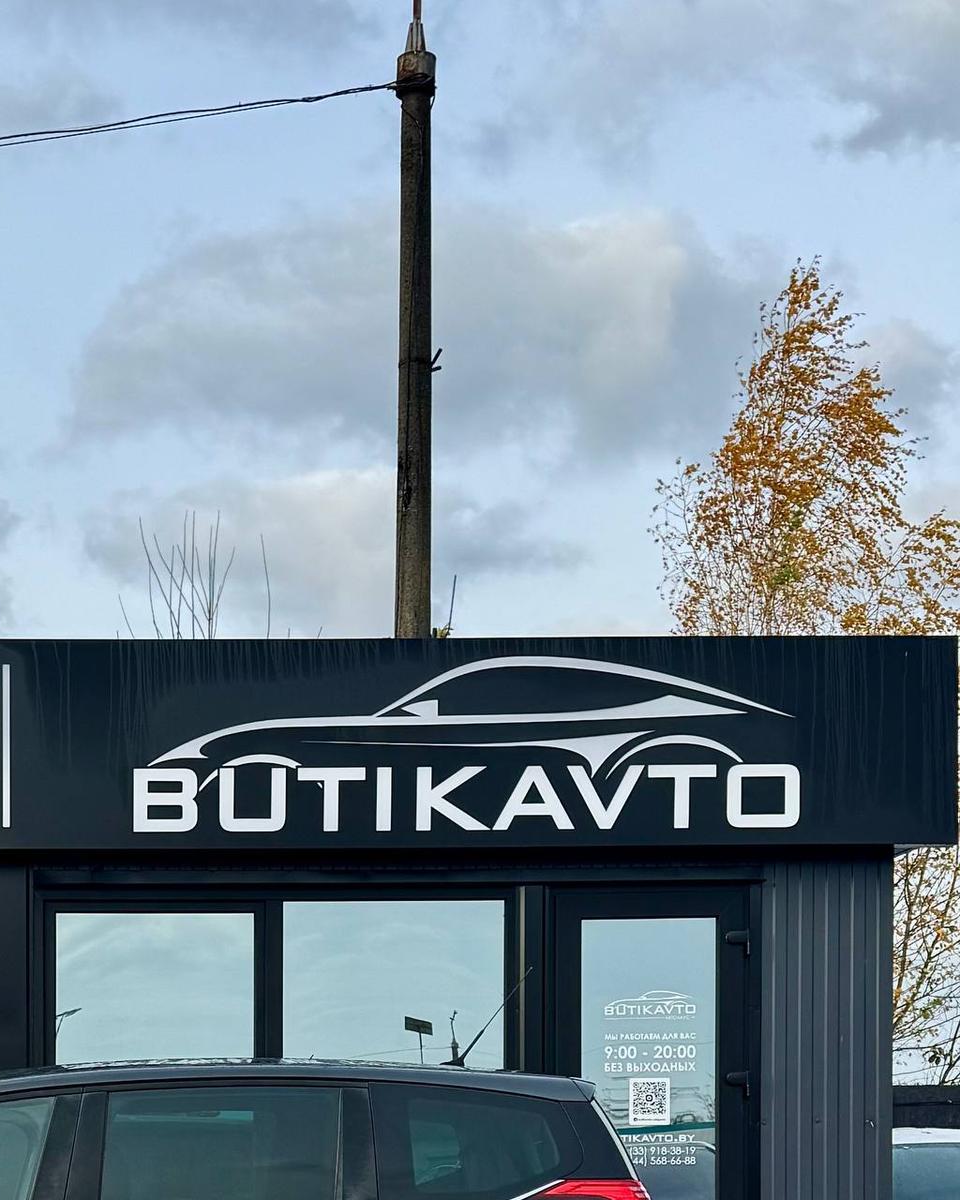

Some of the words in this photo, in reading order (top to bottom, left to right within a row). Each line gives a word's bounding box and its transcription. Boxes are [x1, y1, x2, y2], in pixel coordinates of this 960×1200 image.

[132, 763, 802, 833] BUTIKAVTO
[604, 1004, 696, 1016] BUTIKAVTO
[604, 1033, 619, 1041] МЫ
[620, 1033, 661, 1041] РАБОТАЕМ
[661, 1033, 680, 1041] ДЛЯ
[679, 1032, 697, 1040] ВАС
[604, 1046, 638, 1059] 9:00
[653, 1045, 697, 1059] 20:00
[604, 1062, 623, 1073] БЕЗ
[626, 1061, 697, 1073] ВЫХОДНЫХ
[620, 1134, 696, 1143] TIKAVTO.BY
[649, 1146, 697, 1156] 918-38-19
[631, 1156, 647, 1167] 44)
[649, 1156, 697, 1166] 568-66-88
